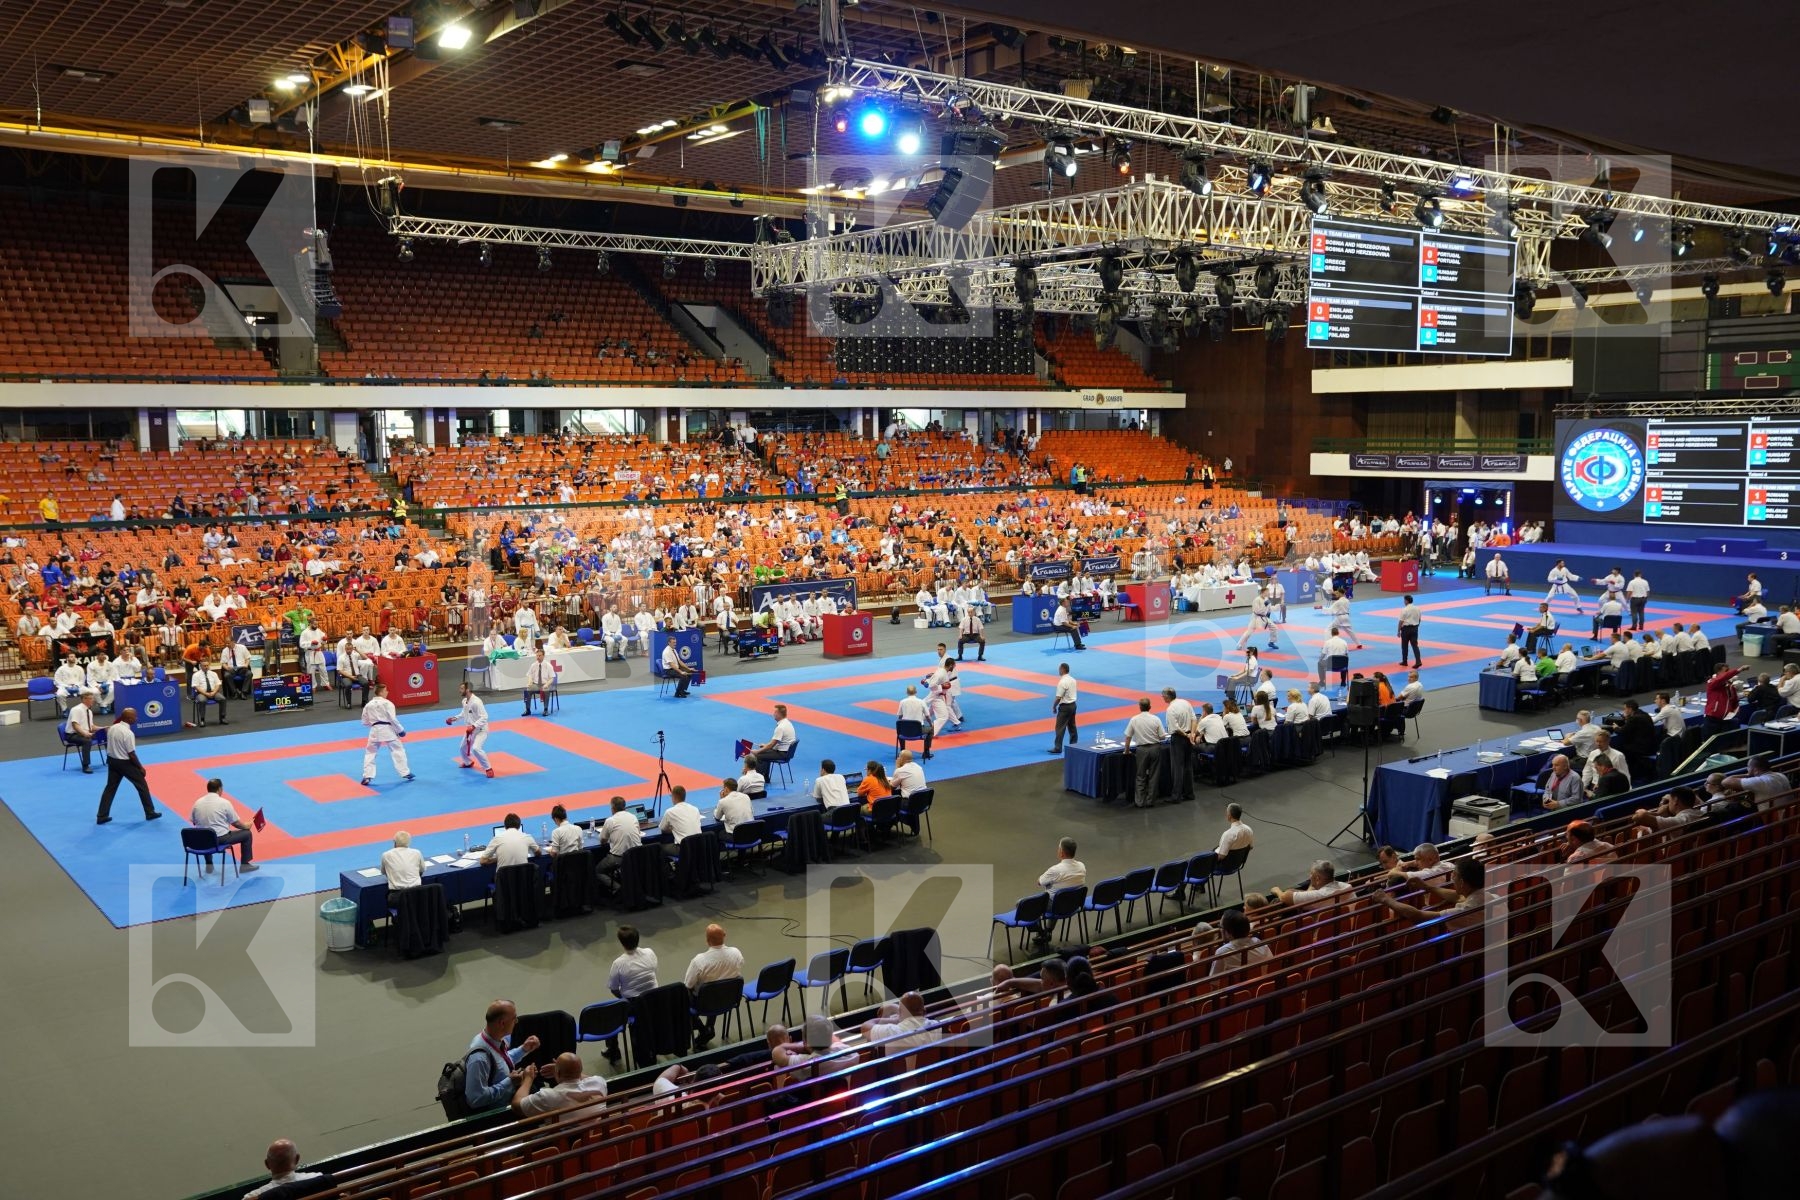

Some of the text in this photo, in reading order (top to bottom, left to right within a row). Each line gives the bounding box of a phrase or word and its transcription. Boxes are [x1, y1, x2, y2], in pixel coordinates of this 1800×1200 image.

[1427, 250, 1432, 258] 0
[1316, 306, 1322, 314] 0
[1427, 313, 1431, 321] 1
[1568, 432, 1637, 458] ФЕДЕРАЦИЈА
[1563, 458, 1584, 500] КАРАТЕ
[1664, 544, 1671, 552] 2
[1721, 544, 1726, 552] 1
[1780, 552, 1788, 560] 3
